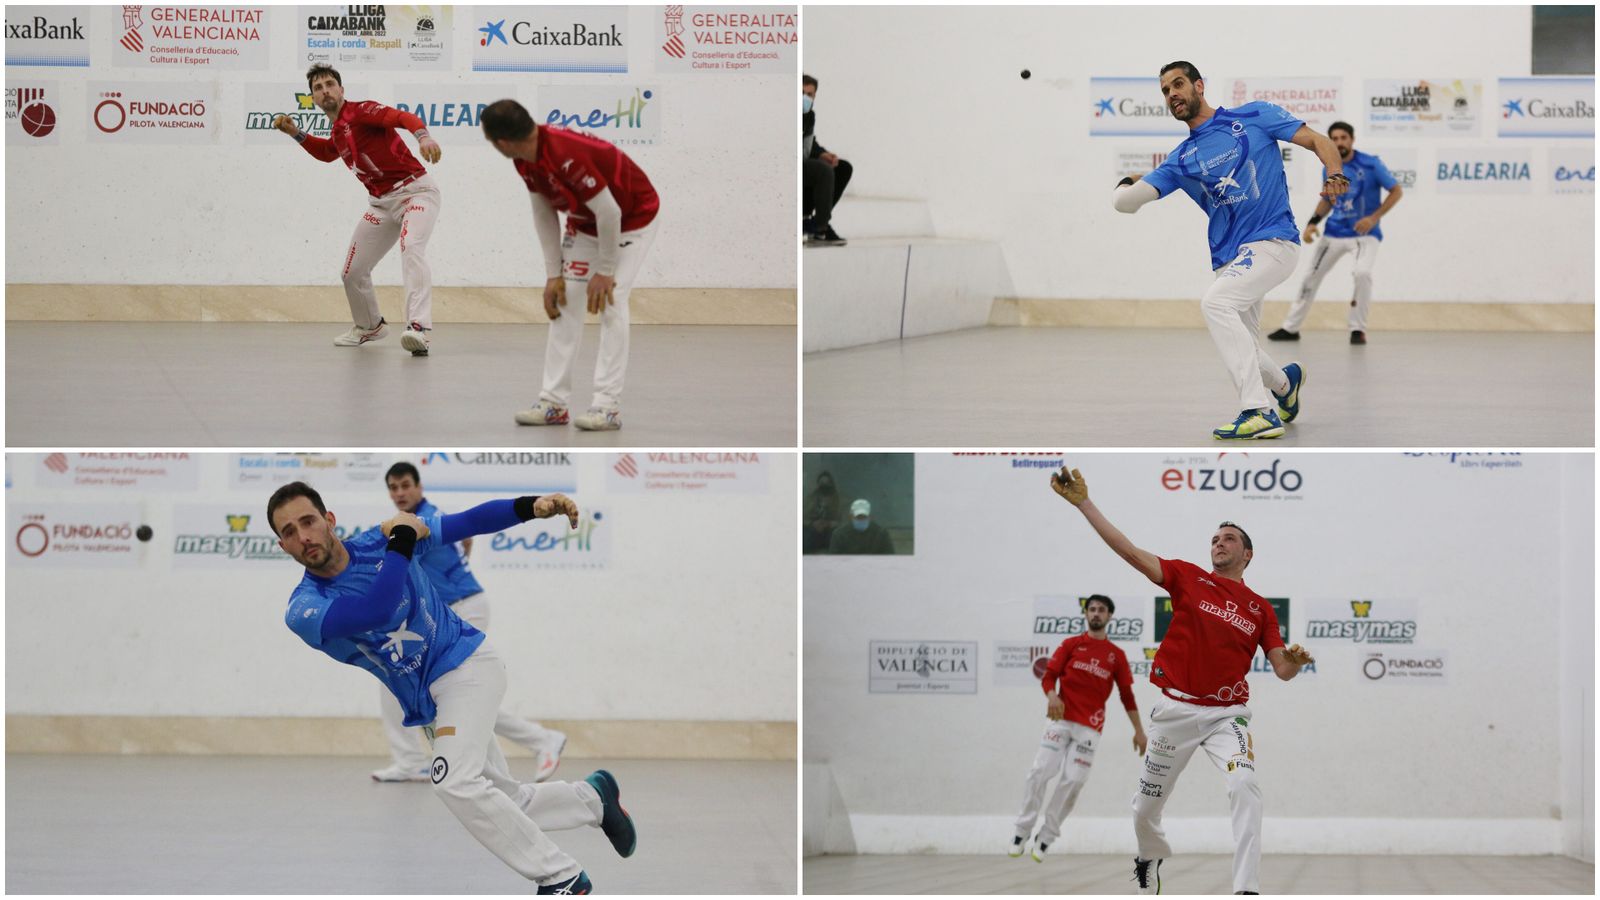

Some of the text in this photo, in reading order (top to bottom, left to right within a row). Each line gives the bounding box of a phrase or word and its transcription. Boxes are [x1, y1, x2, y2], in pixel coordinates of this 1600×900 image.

[151, 8, 263, 24] GENERALITAT
[349, 5, 386, 16] LLIGA
[308, 16, 386, 31] CAIXABANK
[152, 26, 260, 41] VALENCIANA
[512, 22, 623, 47] CaixaBank
[694, 31, 798, 45] VALENCIANA
[307, 38, 335, 48] Escala
[150, 46, 195, 55] Conselleria
[692, 51, 735, 60] Conselleria
[150, 56, 178, 64] Cultura
[184, 56, 210, 65] Esport
[726, 62, 751, 70] Esport
[1253, 90, 1337, 100] GENERALITAT
[1401, 86, 1430, 97] LLIGA
[129, 100, 205, 117] FUNDACIÓ
[1370, 97, 1430, 108] CAIXABANK
[129, 120, 205, 129] PILOTA VALENCIANA
[1161, 459, 1303, 492] elzurdo
[53, 523, 132, 540] FUNDACIÓ
[1199, 600, 1257, 634] masymas
[1306, 620, 1417, 643] masymas
[1388, 657, 1444, 669] FUNDACIÓ
